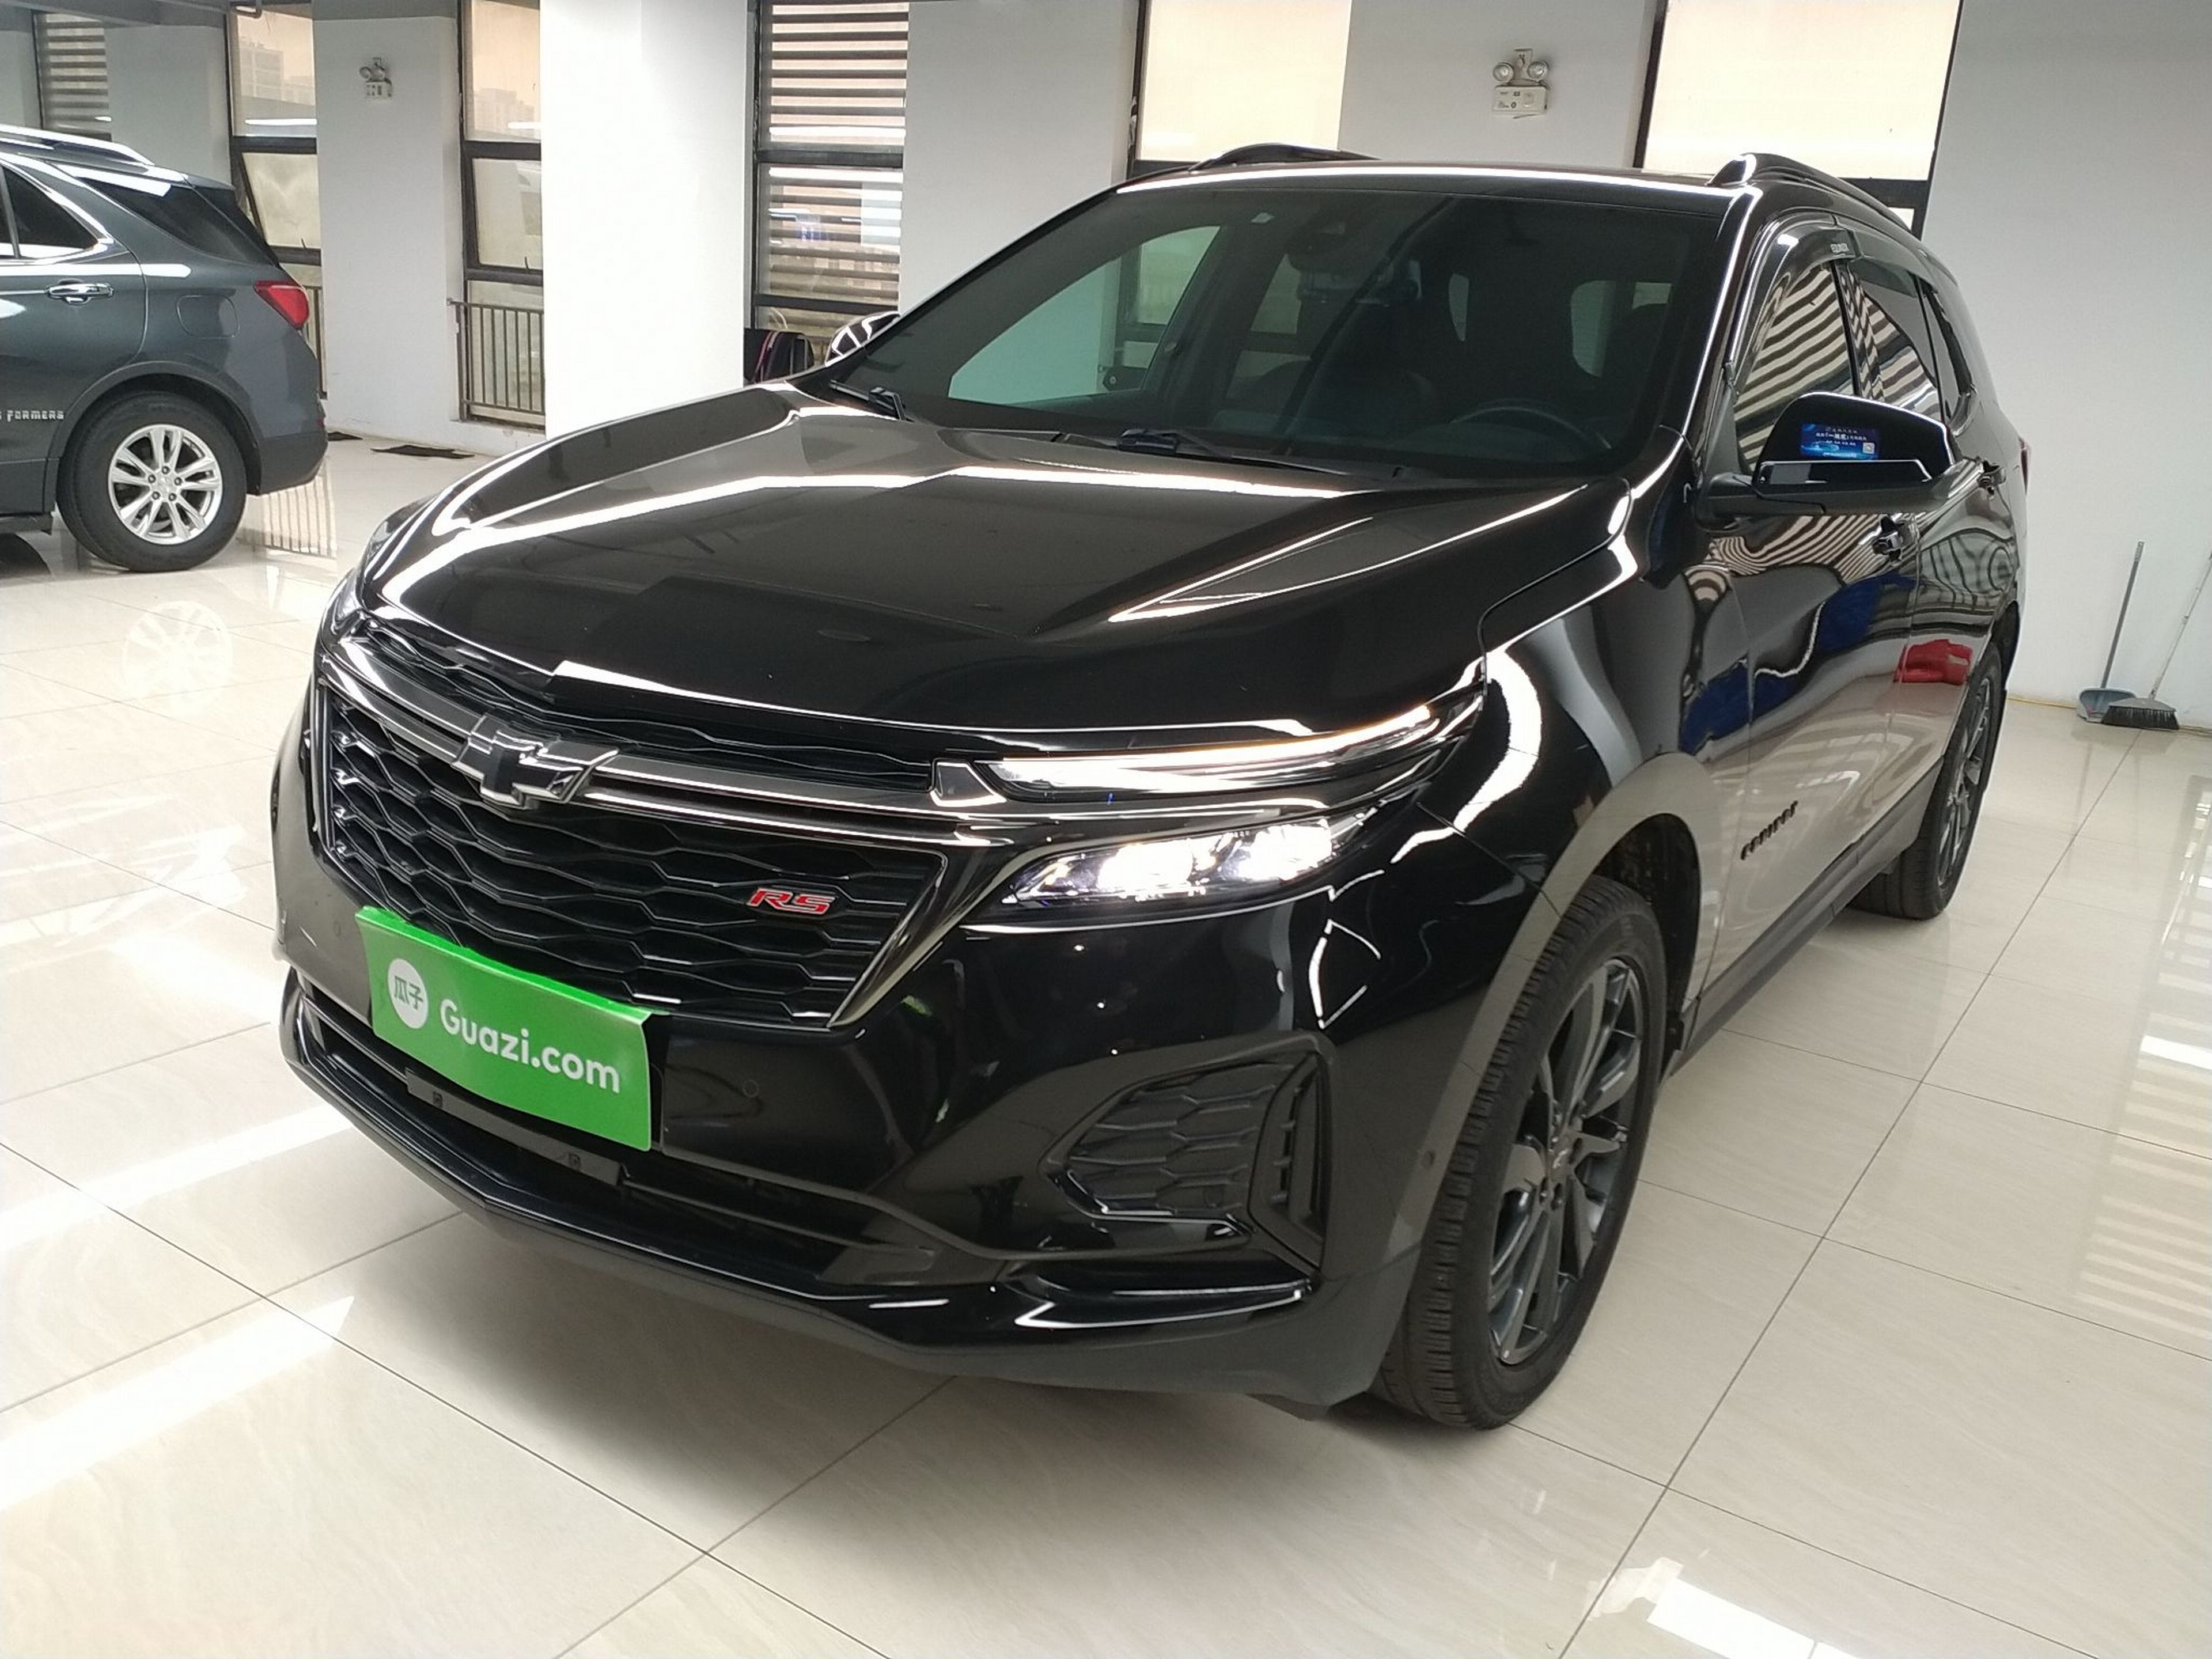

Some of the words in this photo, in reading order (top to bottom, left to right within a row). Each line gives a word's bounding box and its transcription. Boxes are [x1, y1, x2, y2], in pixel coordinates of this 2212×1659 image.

[0, 410, 65, 422] FORMERS
[746, 888, 836, 915] RS
[393, 975, 423, 1011] 瓜子
[440, 998, 620, 1094] Guazi.com
